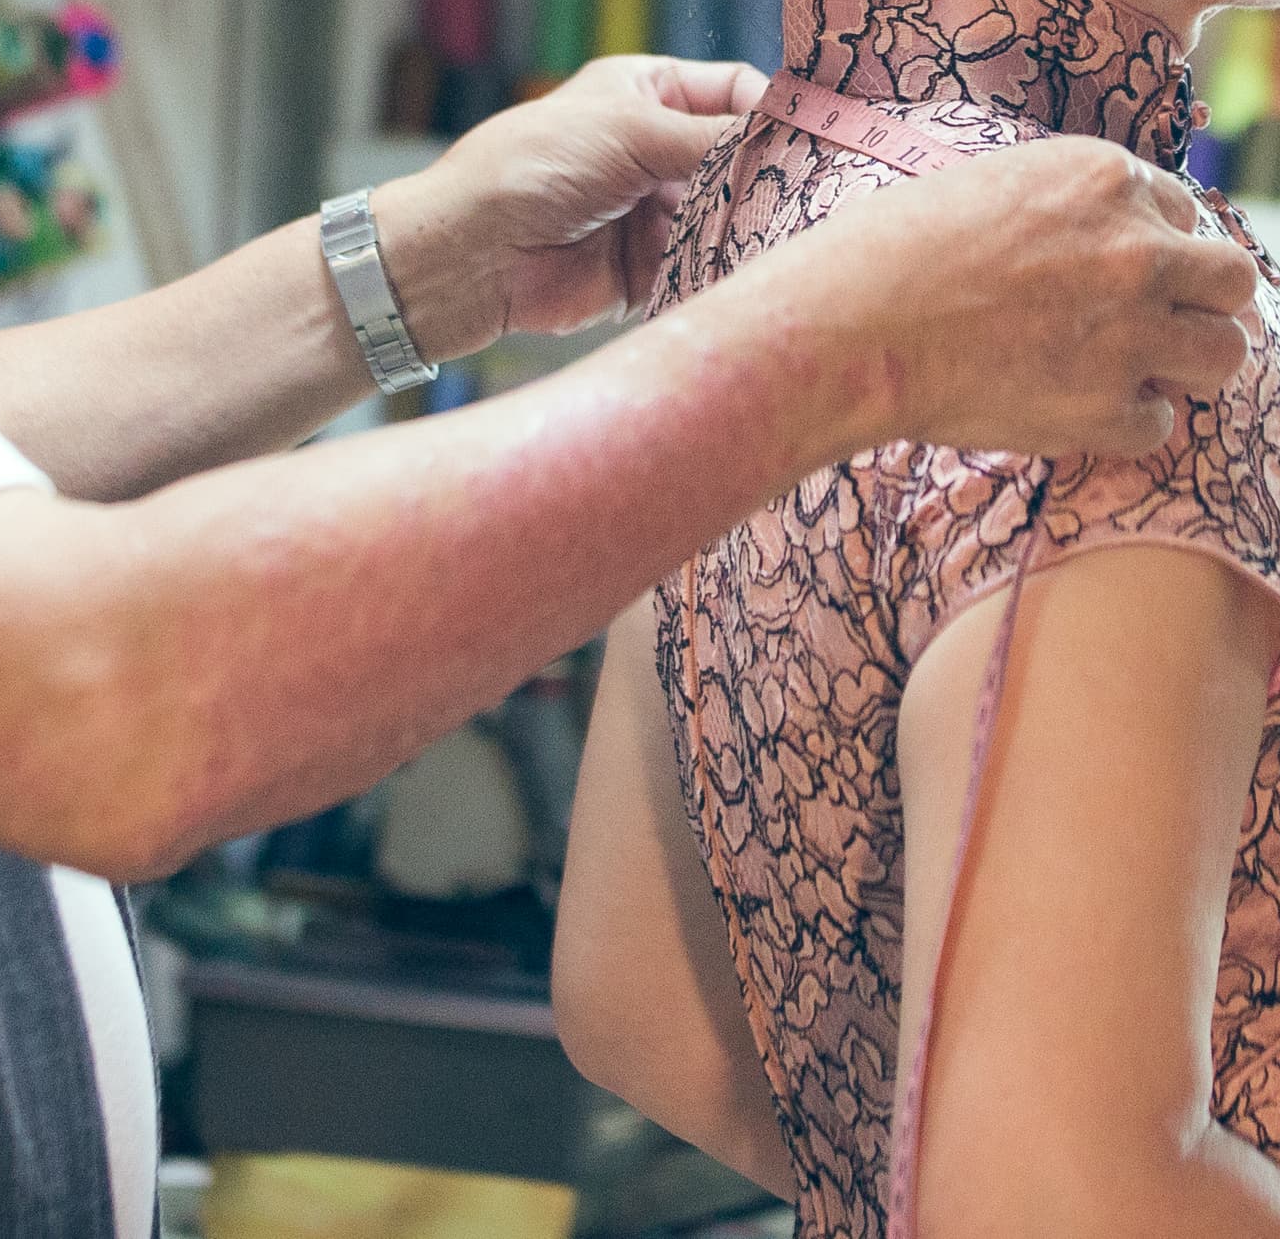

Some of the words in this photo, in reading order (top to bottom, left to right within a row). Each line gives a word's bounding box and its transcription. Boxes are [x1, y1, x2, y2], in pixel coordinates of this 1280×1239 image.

[786, 93, 802, 116] 8
[821, 111, 839, 130] 9
[859, 126, 888, 147] 10
[897, 146, 927, 166] 11
